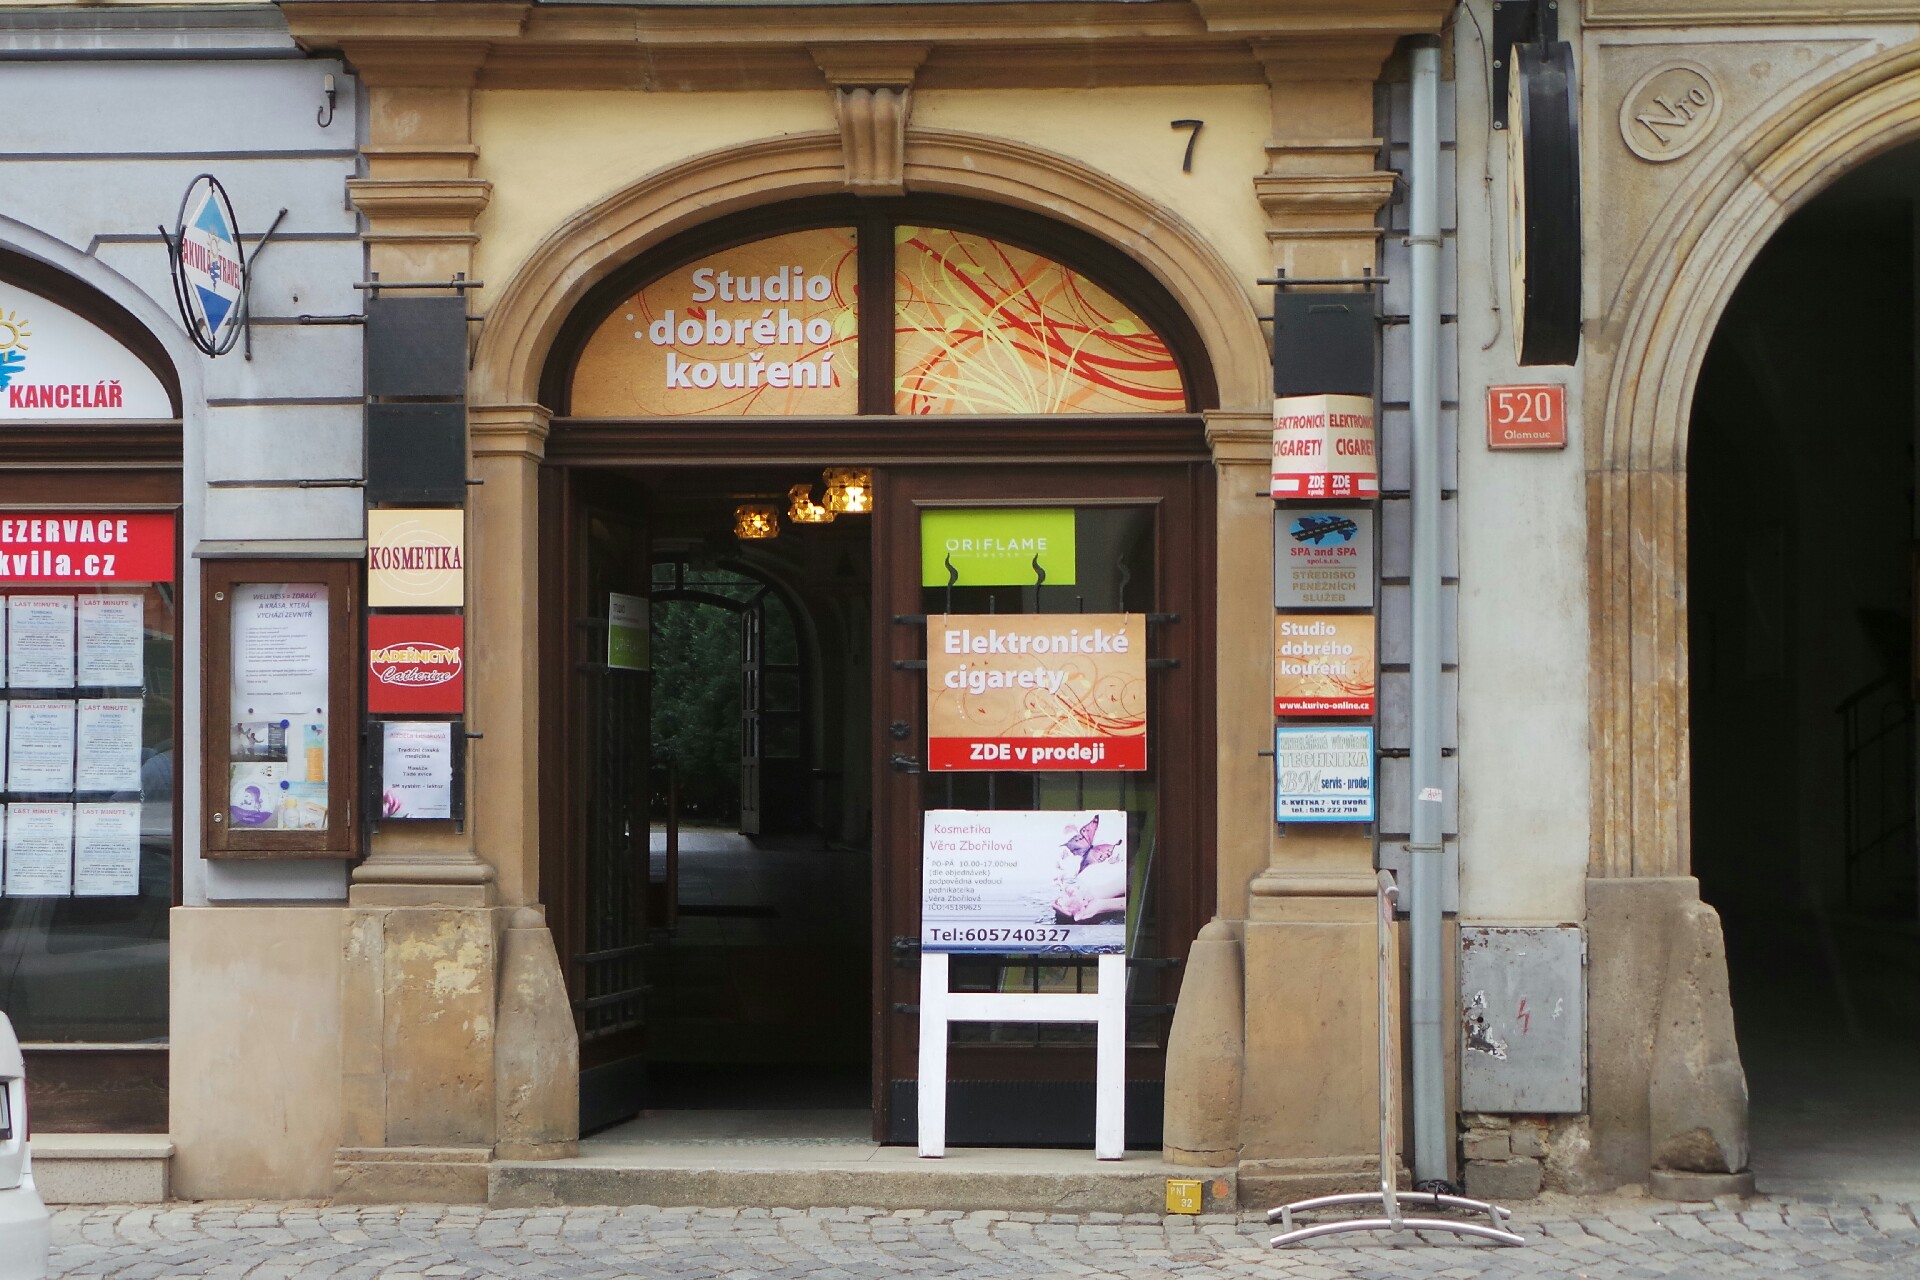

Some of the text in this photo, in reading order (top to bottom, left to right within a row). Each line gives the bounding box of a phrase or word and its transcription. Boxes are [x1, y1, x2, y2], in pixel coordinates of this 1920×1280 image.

[1635, 86, 1709, 145] Nro
[1170, 119, 1204, 173] 7
[218, 254, 240, 290] TRAVEL
[691, 265, 832, 303] Studio
[648, 309, 832, 346] dobrého
[665, 351, 833, 389] kouření
[9, 380, 123, 409] KANCELÁŘ
[1497, 392, 1552, 424] 520
[1503, 429, 1551, 440] Olomouc
[1273, 439, 1323, 457] CIGARETY
[1308, 475, 1325, 488] ZDE
[1332, 475, 1350, 488] ZDE
[945, 538, 1048, 552] ORIFLAME
[1290, 547, 1357, 557] SPA and SPA
[370, 546, 462, 570] KOSMETIKA
[1292, 568, 1356, 580] STŘEDISKO
[1292, 580, 1356, 591] PENĚŽNÍCH
[1302, 592, 1346, 602] SLUŽEB
[1281, 622, 1336, 636] Studio
[944, 628, 1130, 655] Elektronické
[1281, 641, 1353, 655] dobrého
[370, 646, 460, 666] KADEŘNICTVÍ
[380, 666, 452, 684] Catherine
[1281, 660, 1347, 675] kouření
[944, 664, 1067, 695] cigarety
[1280, 701, 1370, 710] www.kurivo-online.cz
[970, 743, 1105, 764] ZDE v prodeji
[1280, 752, 1368, 768] TECHNIKA
[1280, 770, 1322, 793] BM
[1322, 776, 1342, 789] servis
[1347, 776, 1370, 790] prodej
[934, 824, 991, 834] Kosmetika
[930, 840, 1013, 851] Věra Zbořilová
[945, 869, 991, 877] objednávek)
[930, 927, 1072, 944] Tel:605740327
[1181, 1198, 1193, 1208] 32
